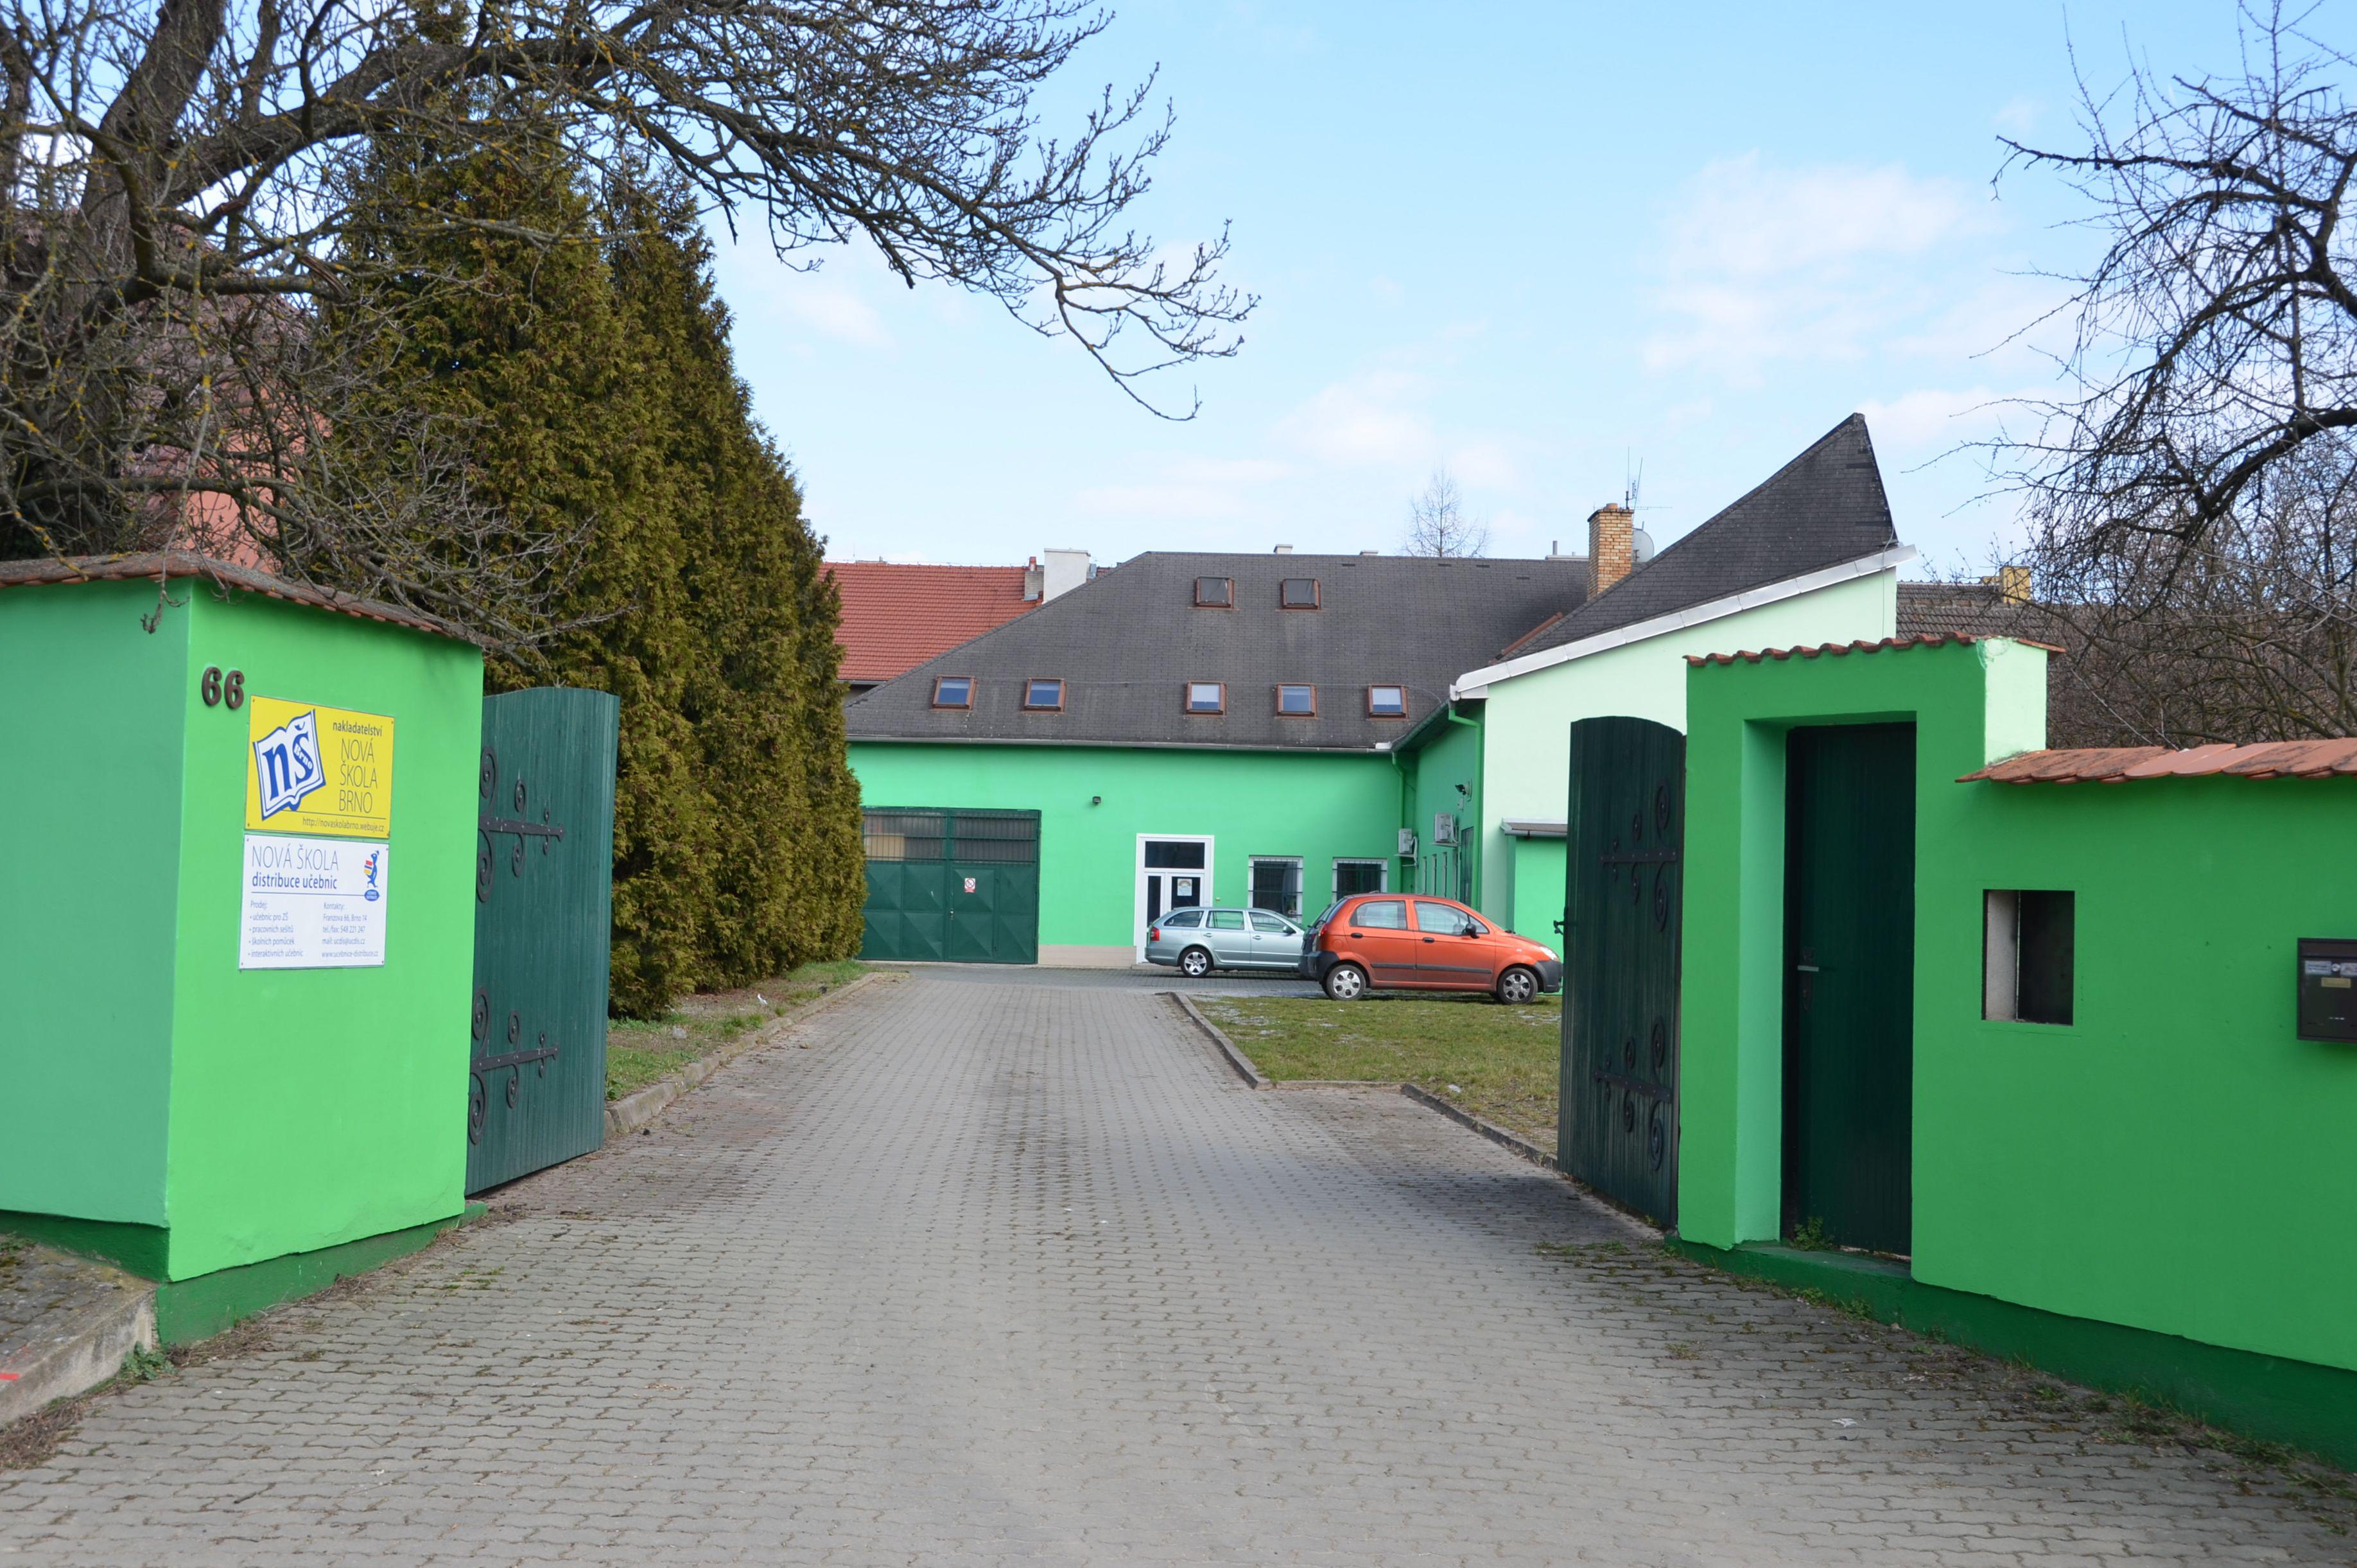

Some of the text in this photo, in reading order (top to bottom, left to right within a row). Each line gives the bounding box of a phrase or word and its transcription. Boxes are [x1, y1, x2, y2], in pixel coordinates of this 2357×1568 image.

[202, 667, 245, 709] 66
[333, 720, 383, 736] nakladatelství
[294, 743, 313, 770] Brno
[341, 738, 374, 763] NOVÁ
[340, 761, 378, 789] ŠKOLA
[339, 789, 373, 814] BRNO
[302, 817, 385, 833] http://novaskolabrno.webuje.cz
[252, 843, 339, 871] NOVÁ ŠKOLA
[252, 872, 337, 889] distribuce učebnic
